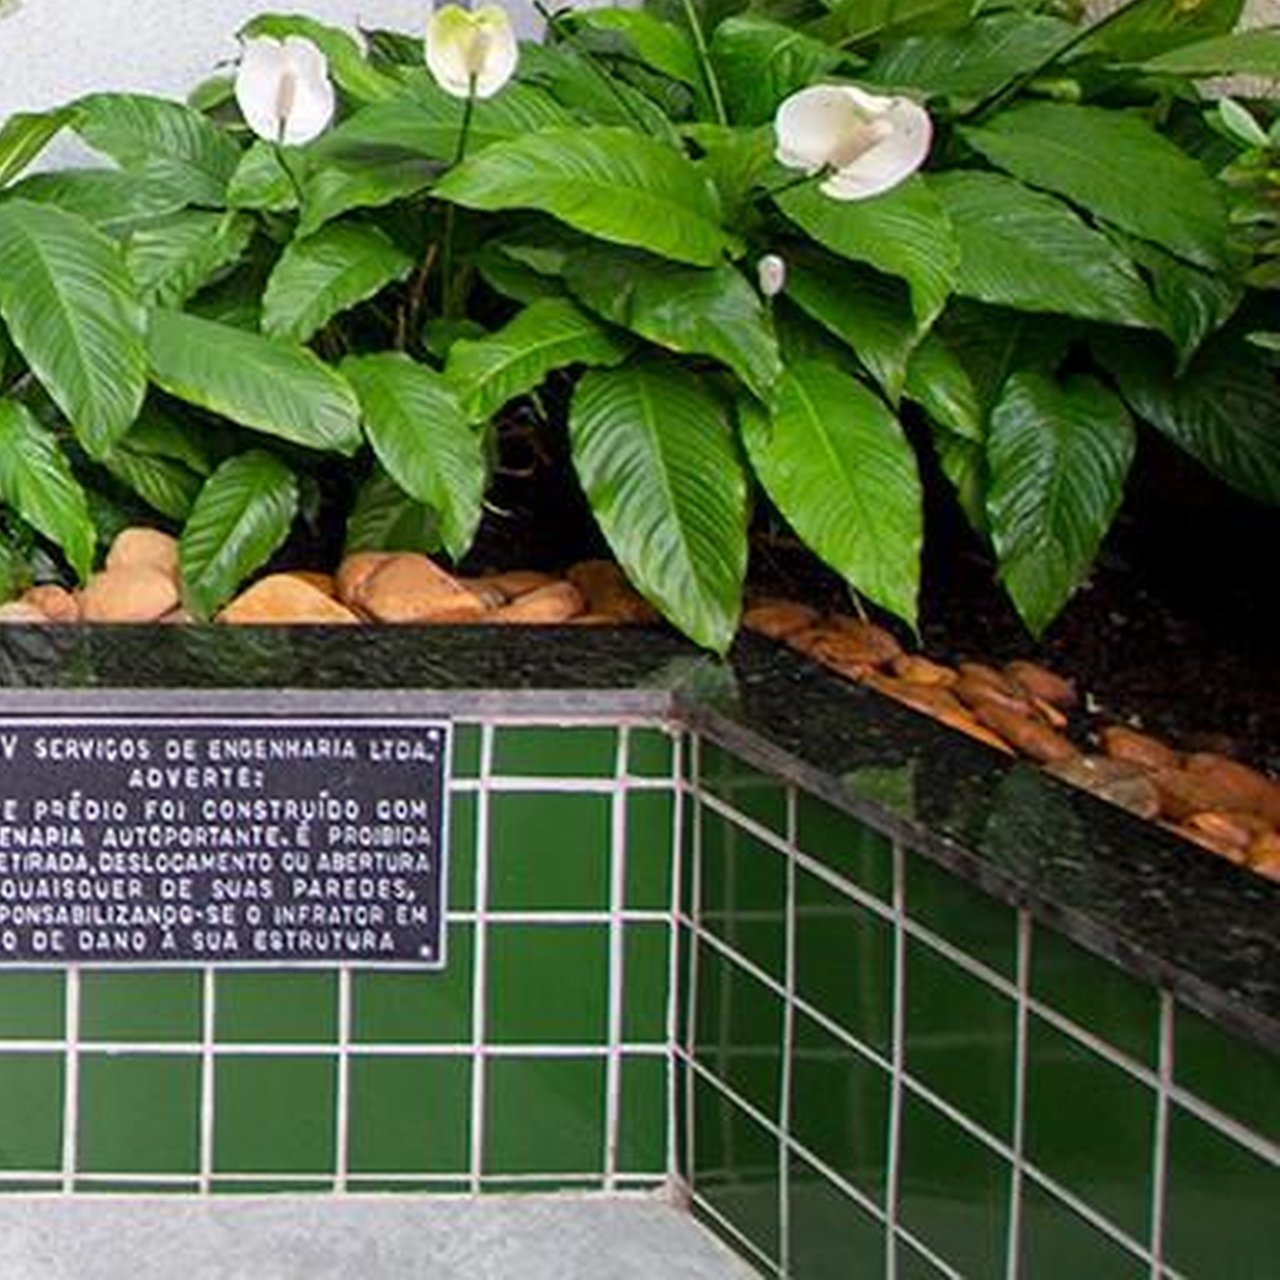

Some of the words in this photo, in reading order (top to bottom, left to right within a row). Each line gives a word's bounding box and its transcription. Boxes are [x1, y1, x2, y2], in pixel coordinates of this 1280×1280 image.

[165, 738, 197, 761] DE
[207, 738, 356, 761] ENGENHARIA
[128, 767, 265, 789] ADVERTE:
[34, 789, 129, 822] PRÉDIO
[144, 799, 186, 822] FOI
[201, 789, 360, 822] CONSTRUÍDO
[376, 799, 428, 821] COM
[328, 825, 432, 847] PROIBIDA
[281, 852, 310, 872] OU
[316, 852, 431, 872] ABERTURA
[0, 878, 143, 900] QUAISQUER
[160, 878, 192, 900] DE
[211, 878, 274, 900] SUAS
[292, 878, 416, 903] PAREDES,
[245, 905, 262, 926] O
[274, 905, 386, 926] INFRATOR
[396, 905, 429, 925] EM
[32, 930, 66, 952] DE
[77, 930, 148, 952] DANO
[192, 930, 239, 951] SUA
[252, 930, 396, 951] ESTRUTURA
